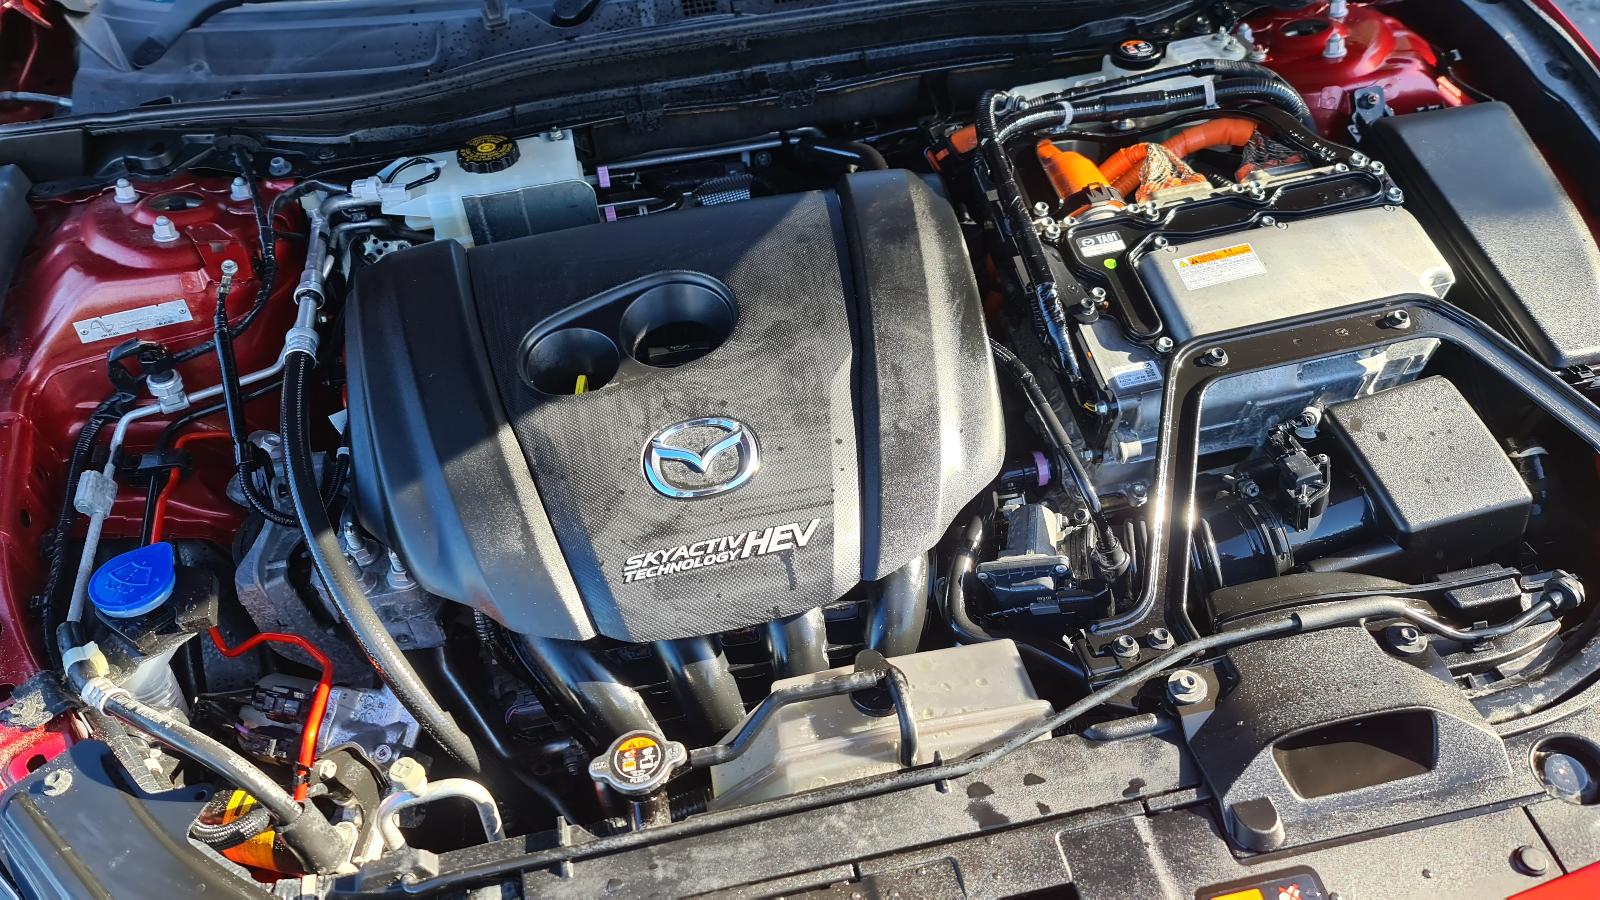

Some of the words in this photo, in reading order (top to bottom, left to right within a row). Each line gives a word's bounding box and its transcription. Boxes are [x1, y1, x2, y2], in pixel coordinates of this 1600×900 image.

[1095, 232, 1118, 244] TA01
[623, 533, 747, 571] SKYACTIV
[740, 519, 821, 558] HEV
[623, 549, 742, 583] TECHNOLOGY
